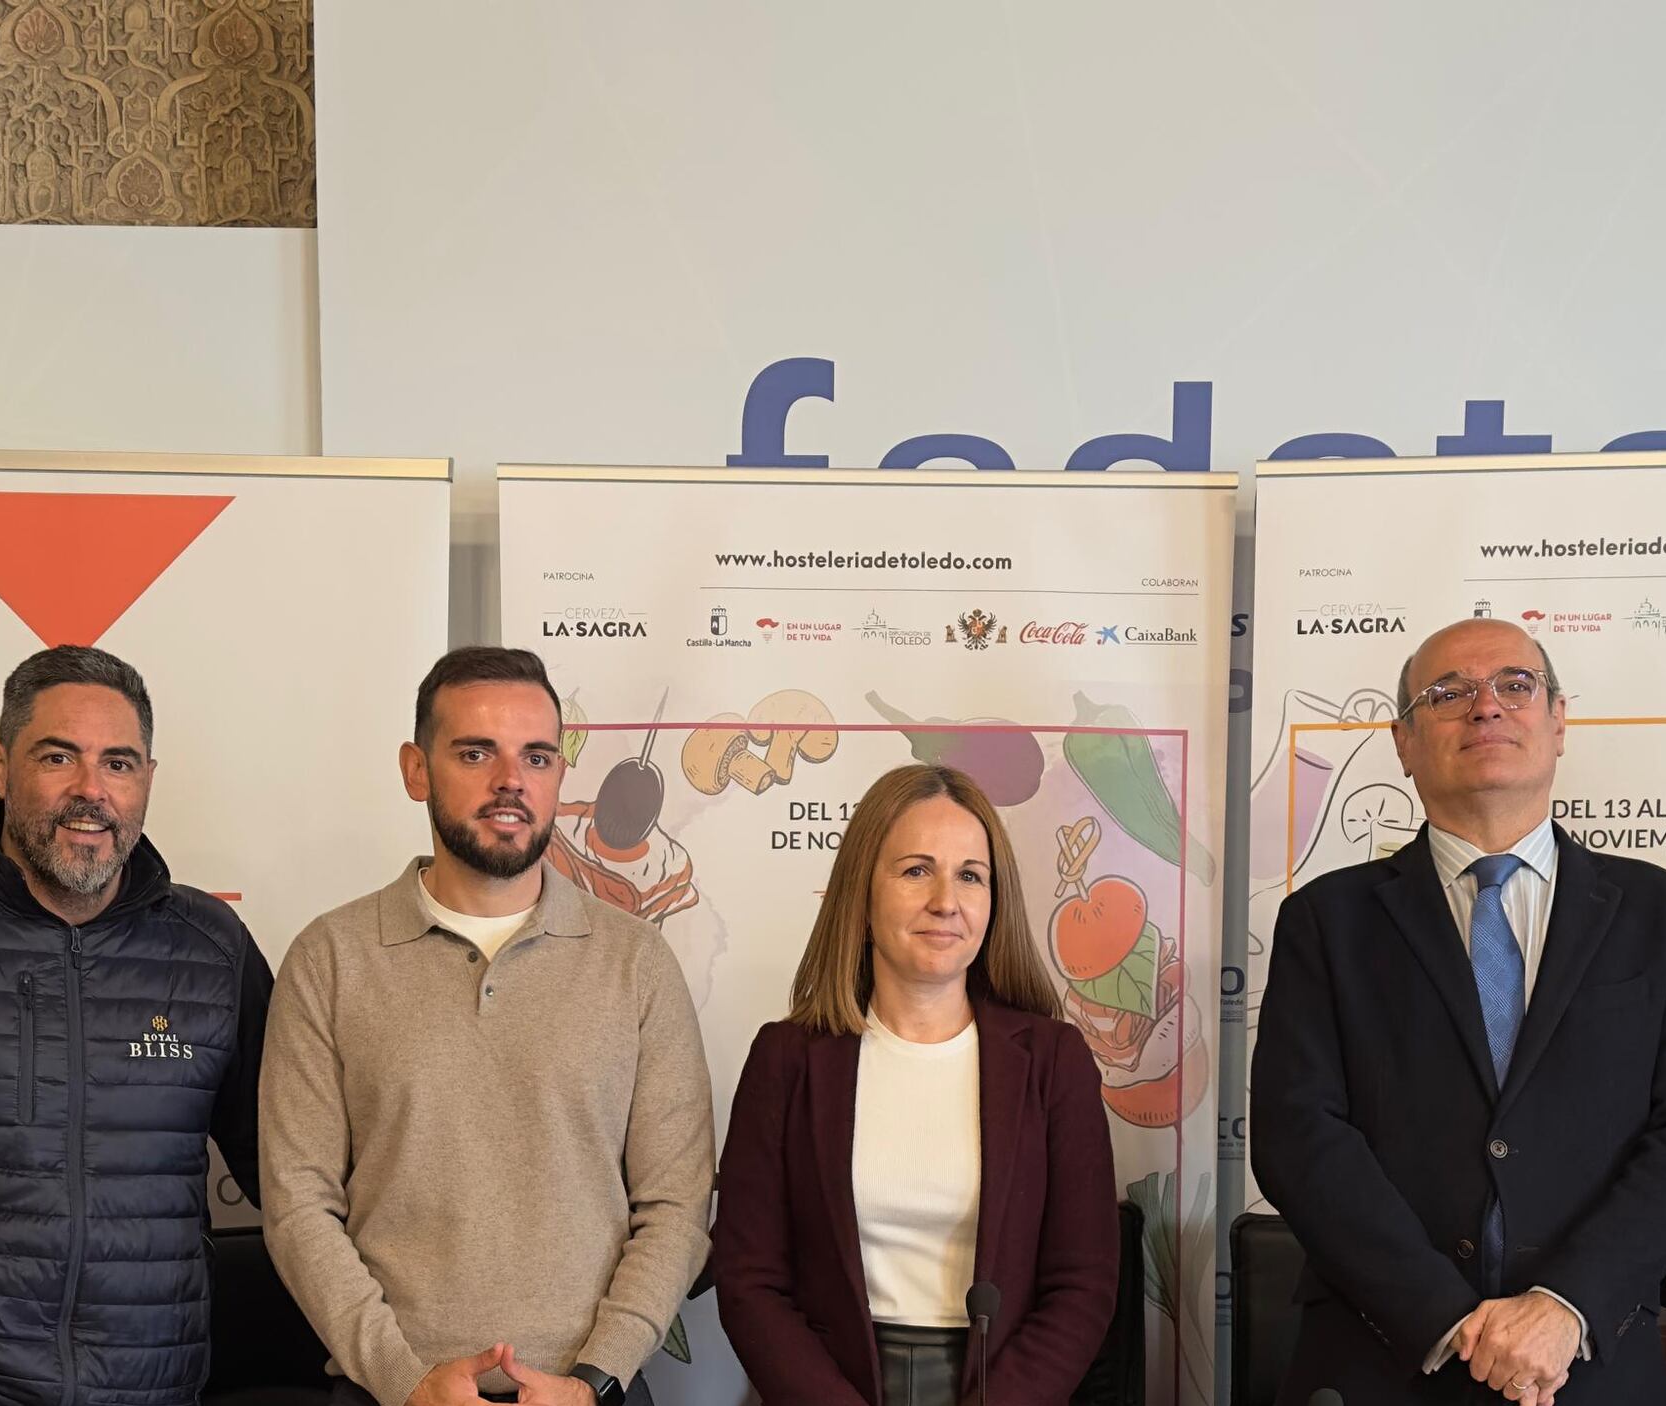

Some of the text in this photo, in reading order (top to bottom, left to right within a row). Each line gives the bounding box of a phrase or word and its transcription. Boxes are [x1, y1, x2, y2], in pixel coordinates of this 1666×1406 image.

[715, 550, 1012, 570] www.hosteleriadetoledo.com
[543, 572, 595, 581] PATROCINA
[1299, 568, 1352, 577] PATROCINA
[1141, 578, 1198, 587] COLABORAN
[564, 608, 626, 619] CERVEZA
[1320, 604, 1383, 616] CERVEZA
[1582, 613, 1612, 621] LUGAR
[813, 623, 841, 631] LUGAR
[1581, 624, 1601, 632] VIDA
[1124, 627, 1197, 642] CaixaBank
[889, 637, 931, 646] TOLEDO
[789, 802, 832, 821] DEL
[1552, 799, 1597, 819] DEL
[1604, 799, 1631, 818] 13
[771, 831, 801, 850] DE
[143, 1033, 179, 1042] ROYAL
[129, 1042, 193, 1060] BLISS
